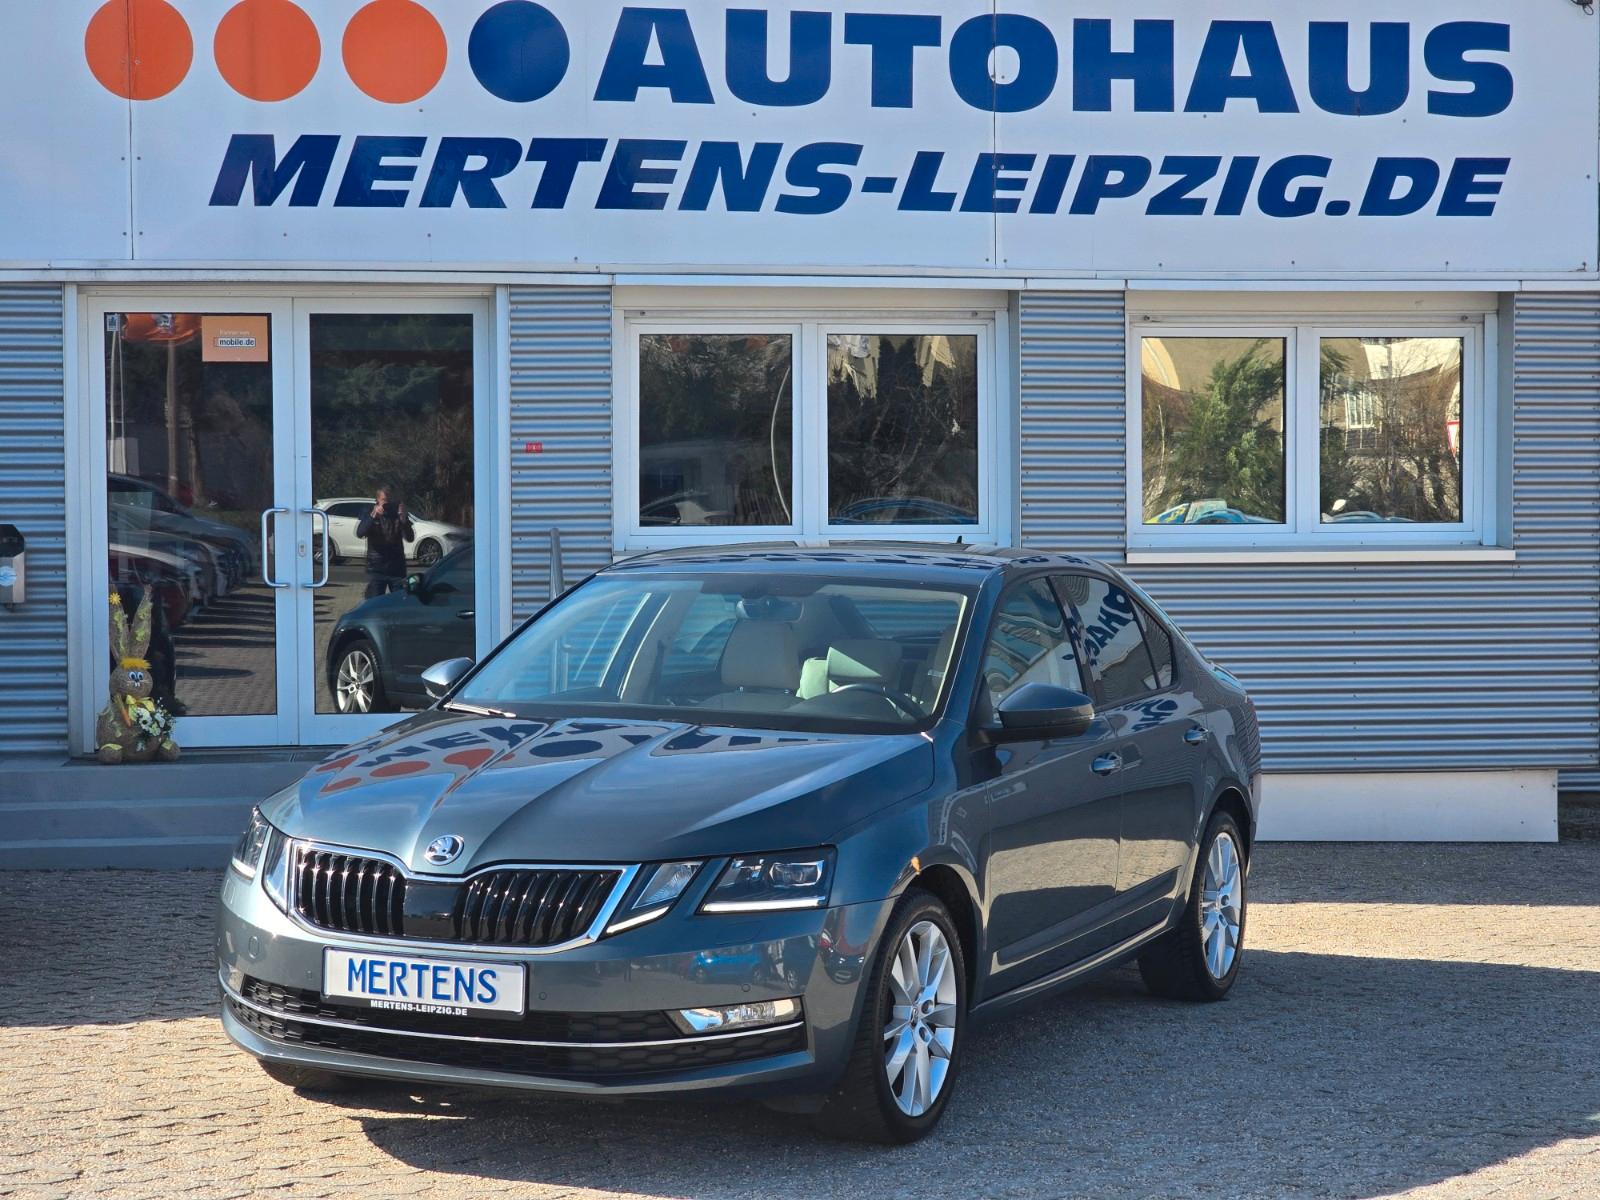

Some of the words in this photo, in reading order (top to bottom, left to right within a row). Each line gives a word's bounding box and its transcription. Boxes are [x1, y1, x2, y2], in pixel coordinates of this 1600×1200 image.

[593, 7, 1513, 117] AUTOHAUS
[209, 134, 1511, 217] MERTENS-LEIPZIG.DE
[219, 338, 255, 346] mobile.de
[347, 958, 497, 1004] MERTENS
[370, 999, 468, 1016] MERTENS-LEIPZIG.DE
